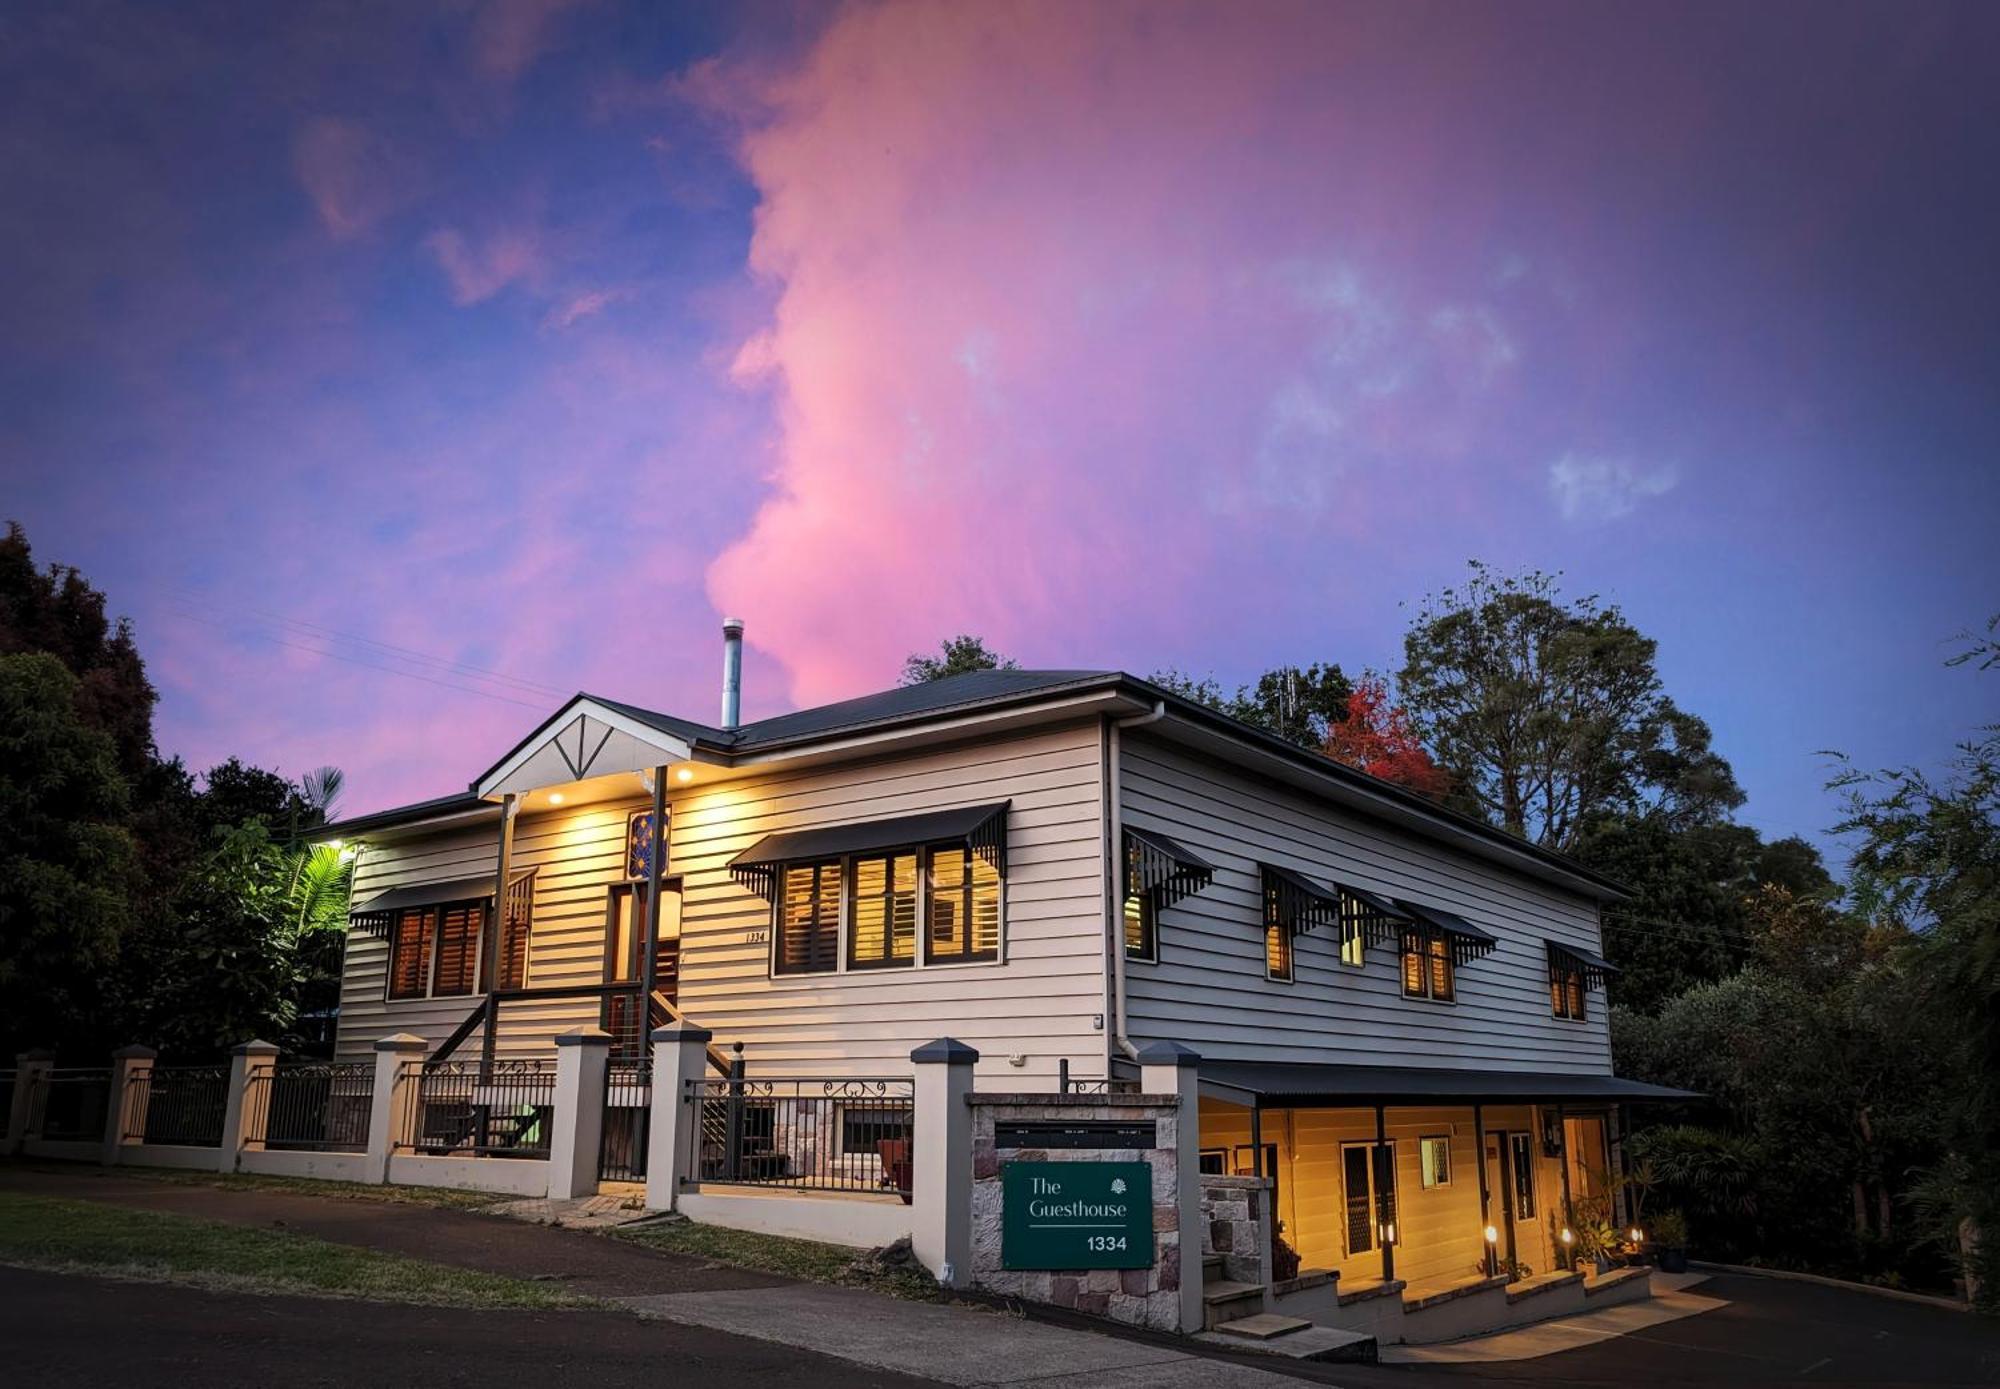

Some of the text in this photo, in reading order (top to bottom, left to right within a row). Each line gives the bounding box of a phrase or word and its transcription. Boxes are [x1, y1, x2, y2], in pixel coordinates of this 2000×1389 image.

[746, 932, 765, 942] 1334
[1029, 1177, 1061, 1195] The
[1029, 1200, 1127, 1217] Guesthouse
[1087, 1236, 1127, 1251] 1334
